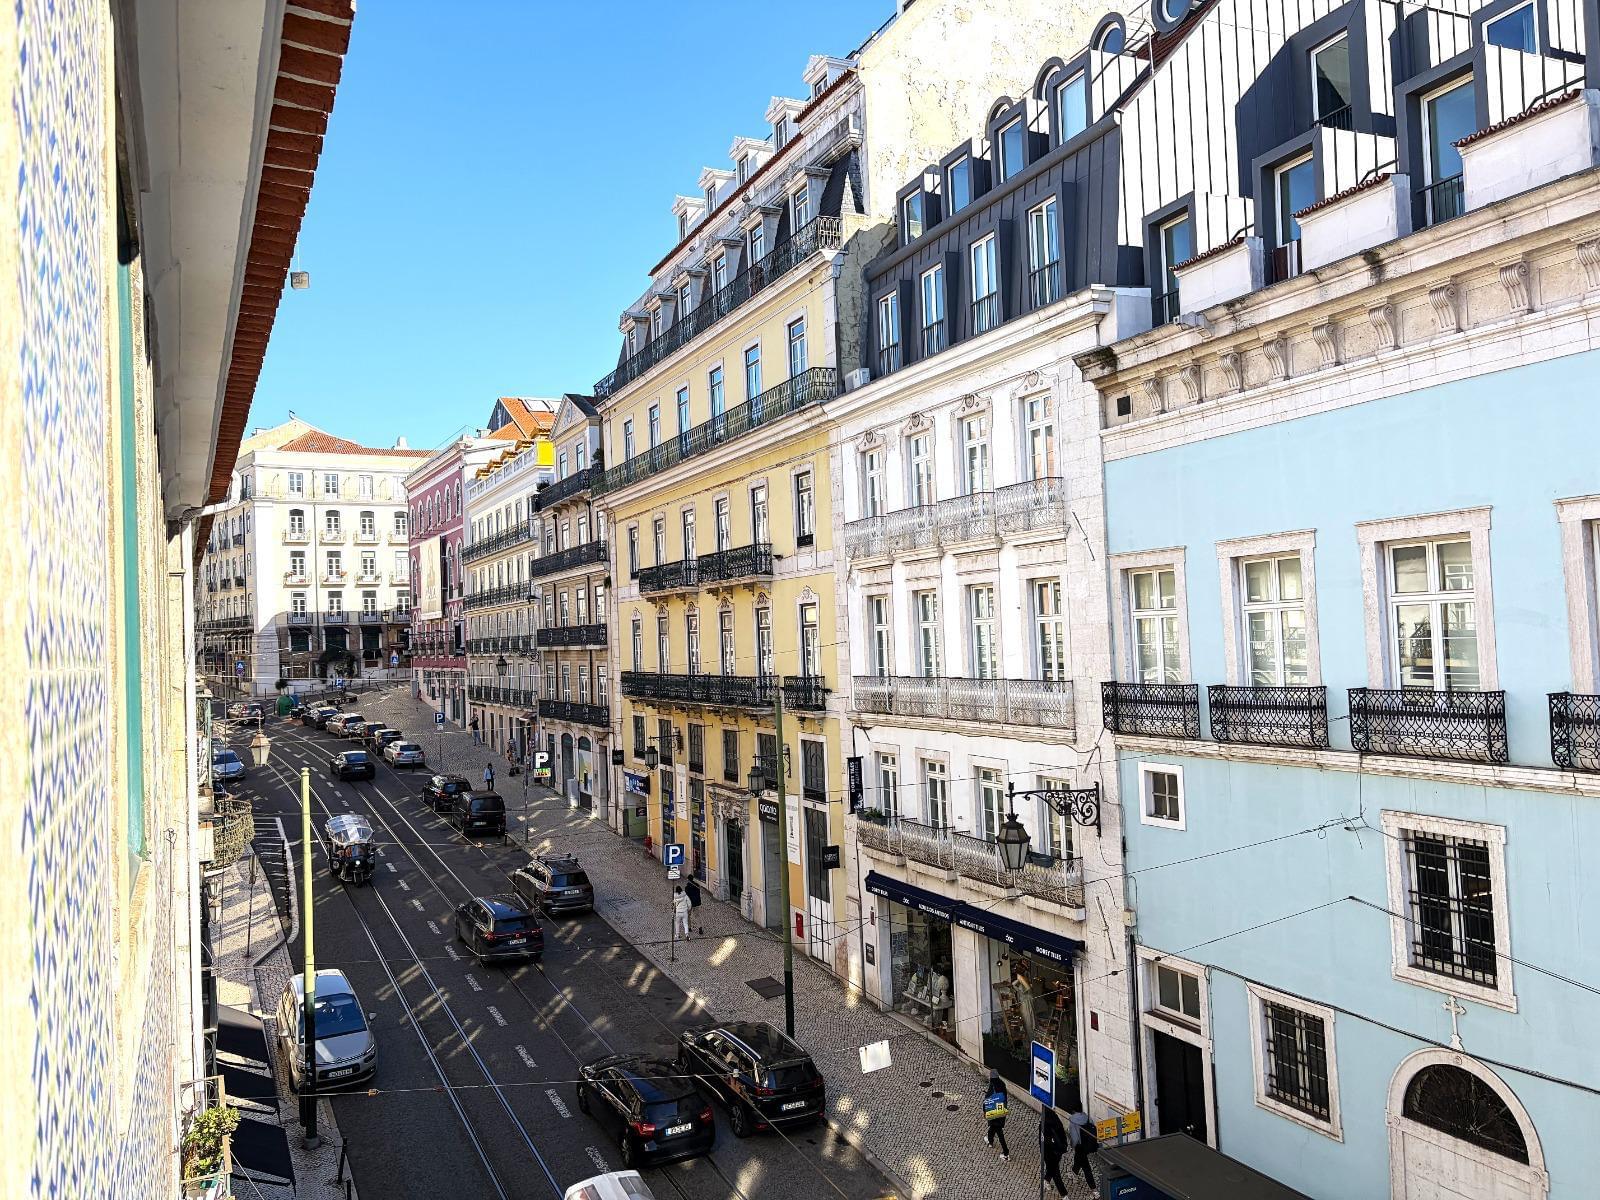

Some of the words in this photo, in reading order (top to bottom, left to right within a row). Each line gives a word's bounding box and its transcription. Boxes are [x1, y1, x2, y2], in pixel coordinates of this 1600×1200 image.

[436, 713, 444, 723] P
[535, 752, 549, 768] P
[669, 846, 681, 864] P
